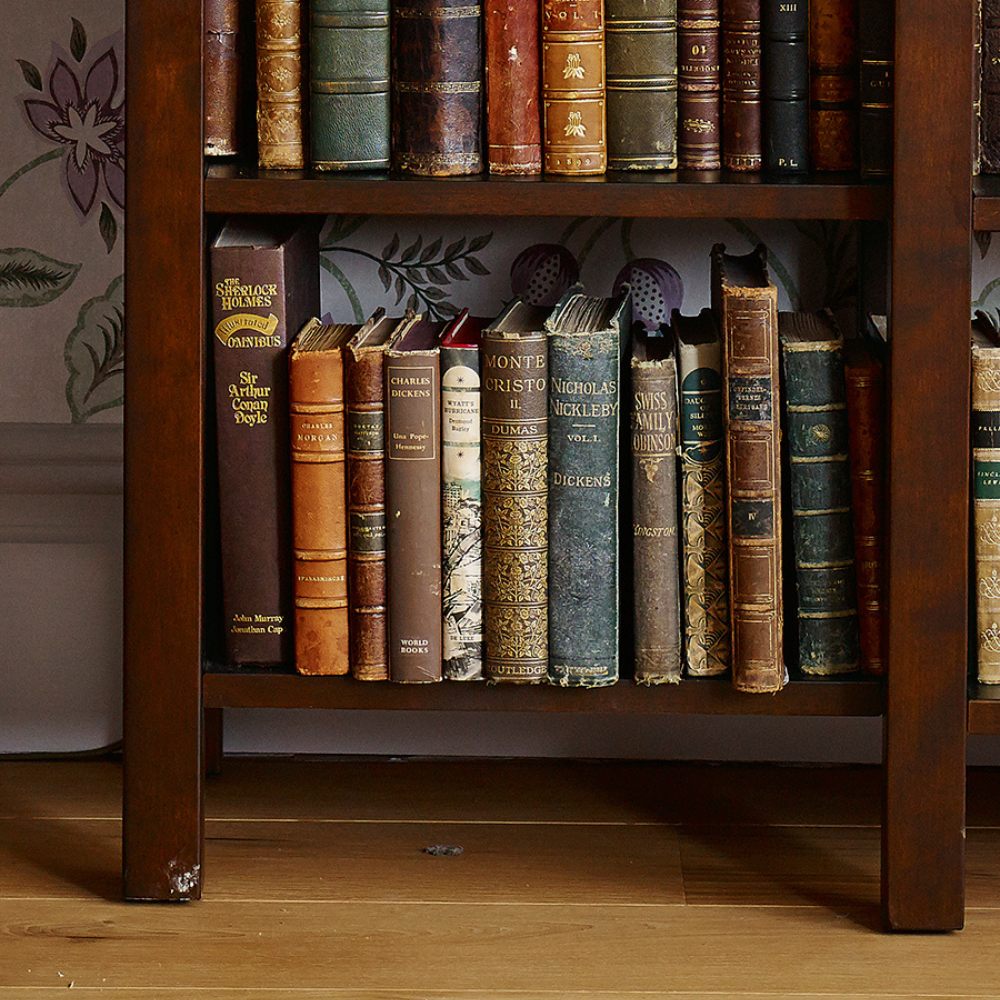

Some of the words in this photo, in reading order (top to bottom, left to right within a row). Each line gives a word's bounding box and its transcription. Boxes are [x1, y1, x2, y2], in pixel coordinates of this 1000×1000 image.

[779, 3, 797, 12] XIII
[691, 44, 708, 55] 10
[224, 277, 240, 286] THE
[215, 282, 278, 298] SHERLOCK
[221, 296, 272, 311] HOLMES
[227, 335, 281, 349] OMNIBUS
[485, 354, 545, 369] MONTE
[239, 371, 258, 385] Sir
[390, 377, 431, 385] CHARLES
[485, 378, 546, 392] CRISTO
[228, 383, 271, 399] Arthur
[551, 377, 617, 395] NICHOLAS
[391, 389, 431, 398] DICKENS
[231, 397, 269, 412] Conan
[634, 391, 668, 411] SWISS
[550, 399, 618, 418] NICKLEBY
[234, 410, 268, 427] Doyle
[631, 411, 674, 431] AMILY
[393, 432, 407, 440] Una
[409, 432, 430, 441] Pope-
[491, 425, 538, 435] DUMAS
[297, 433, 338, 442] MORGAN
[633, 433, 676, 451] OBINSON
[395, 443, 426, 452] Hennessy
[553, 472, 612, 488] DICKENS
[233, 613, 253, 622] John
[254, 614, 283, 624] Murray
[230, 625, 266, 634] Jonathan
[488, 665, 548, 675] OUTLEDGE
